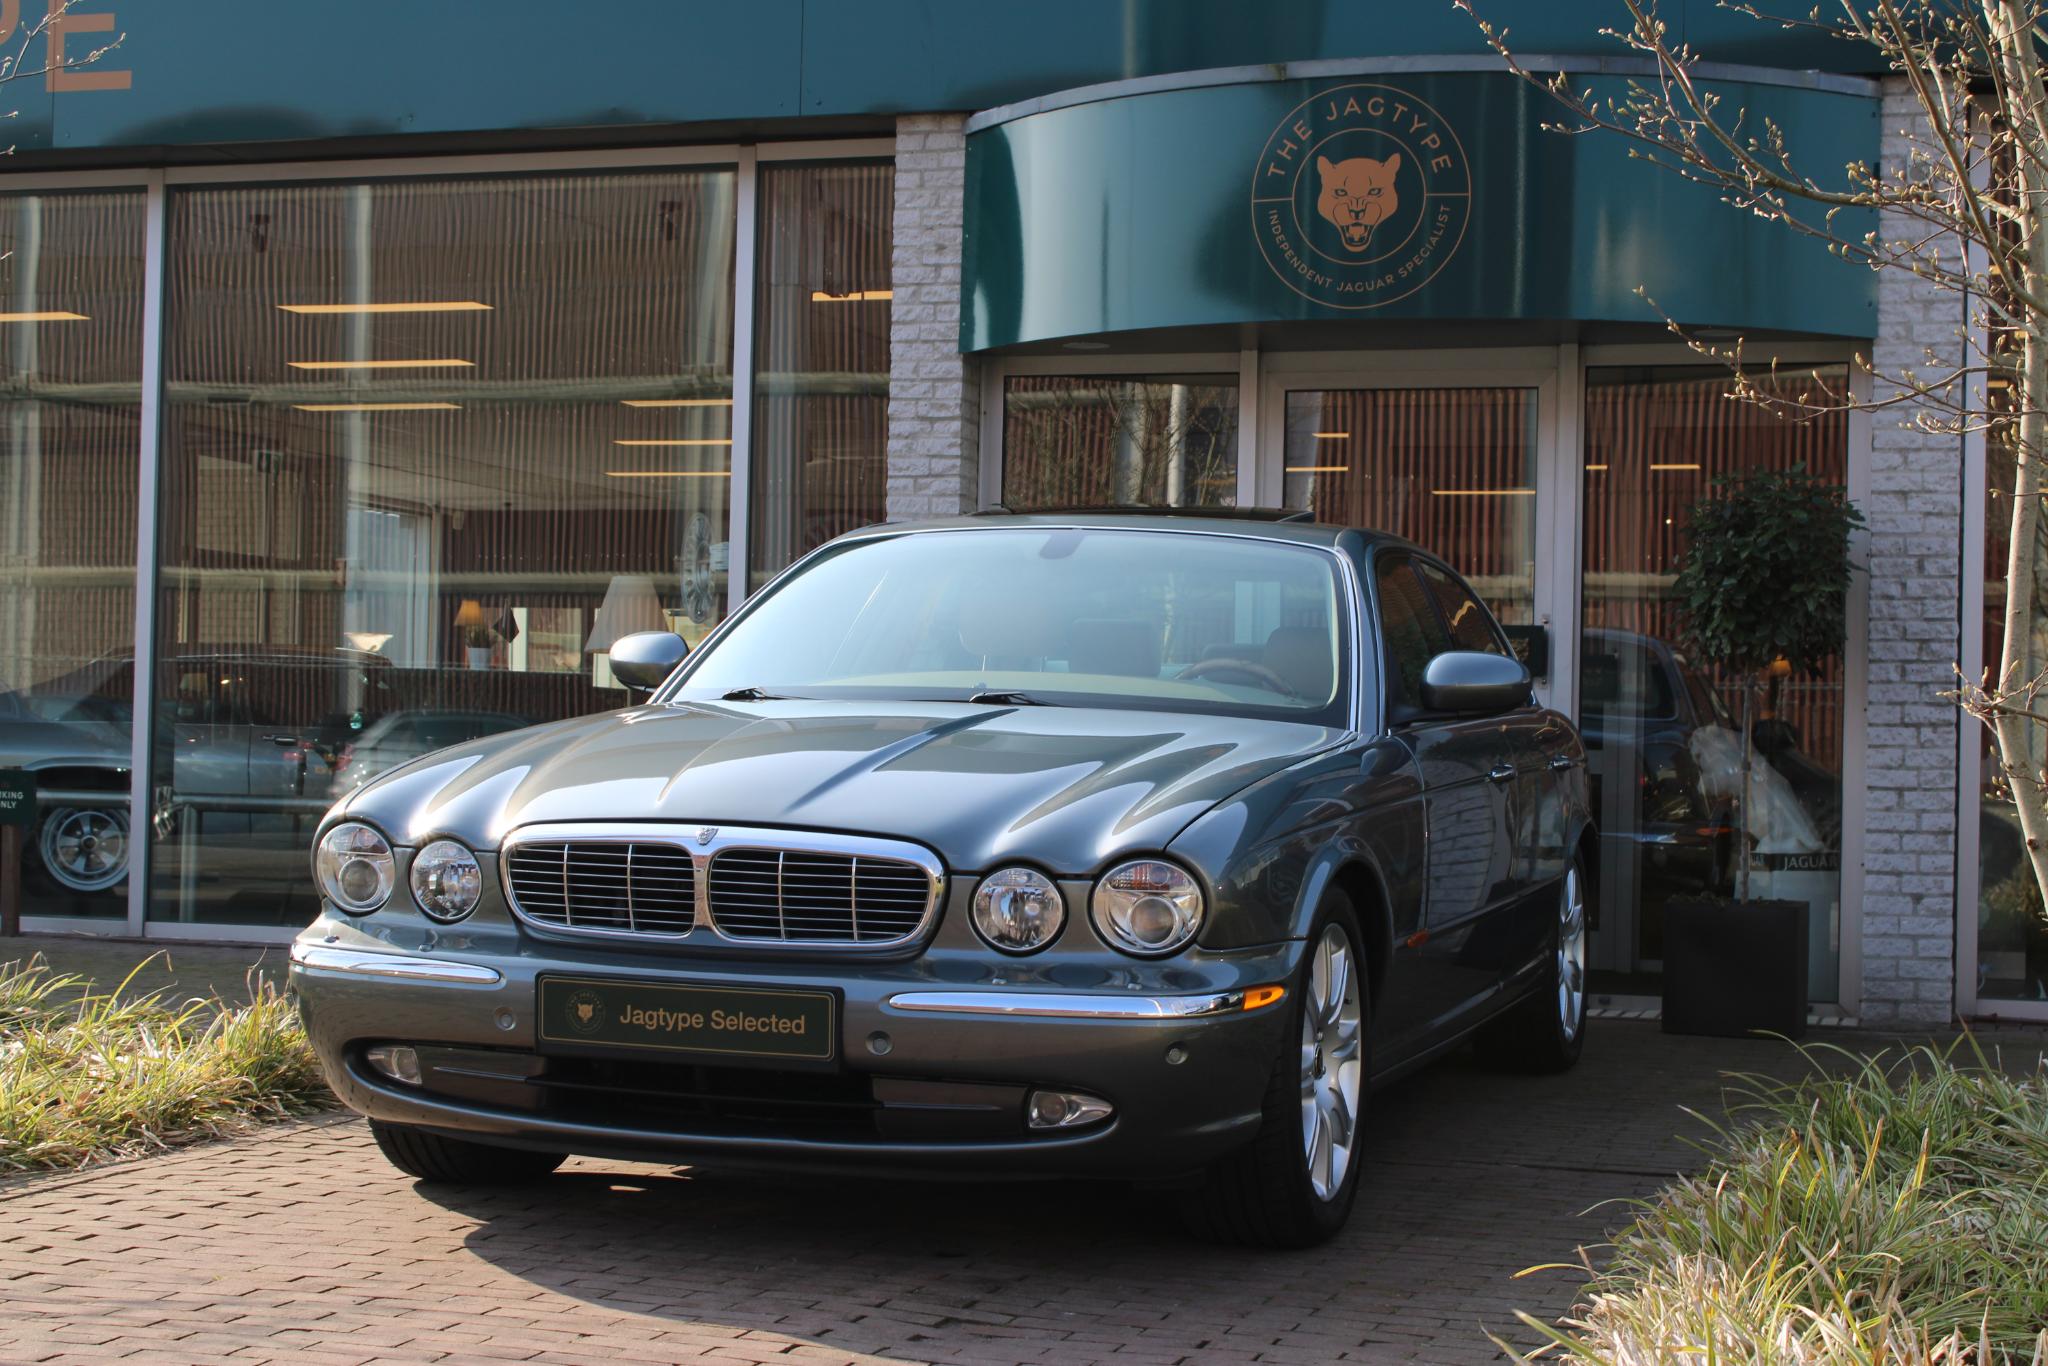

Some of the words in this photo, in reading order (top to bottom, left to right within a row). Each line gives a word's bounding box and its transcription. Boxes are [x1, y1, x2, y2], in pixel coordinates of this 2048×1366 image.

[0, 0, 132, 92] E
[1267, 119, 1313, 177] THE
[1326, 97, 1452, 174] JAGTYPE
[1269, 209, 1333, 288] INDEPENDENT
[1336, 274, 1395, 292] JAGUAR
[1398, 204, 1451, 278] SPECIALIST
[0, 791, 24, 800] KING
[0, 800, 17, 809] NLY
[1784, 855, 1838, 871] JAGUAR
[619, 1004, 704, 1031] Jagtype
[710, 1010, 805, 1034] Selected
